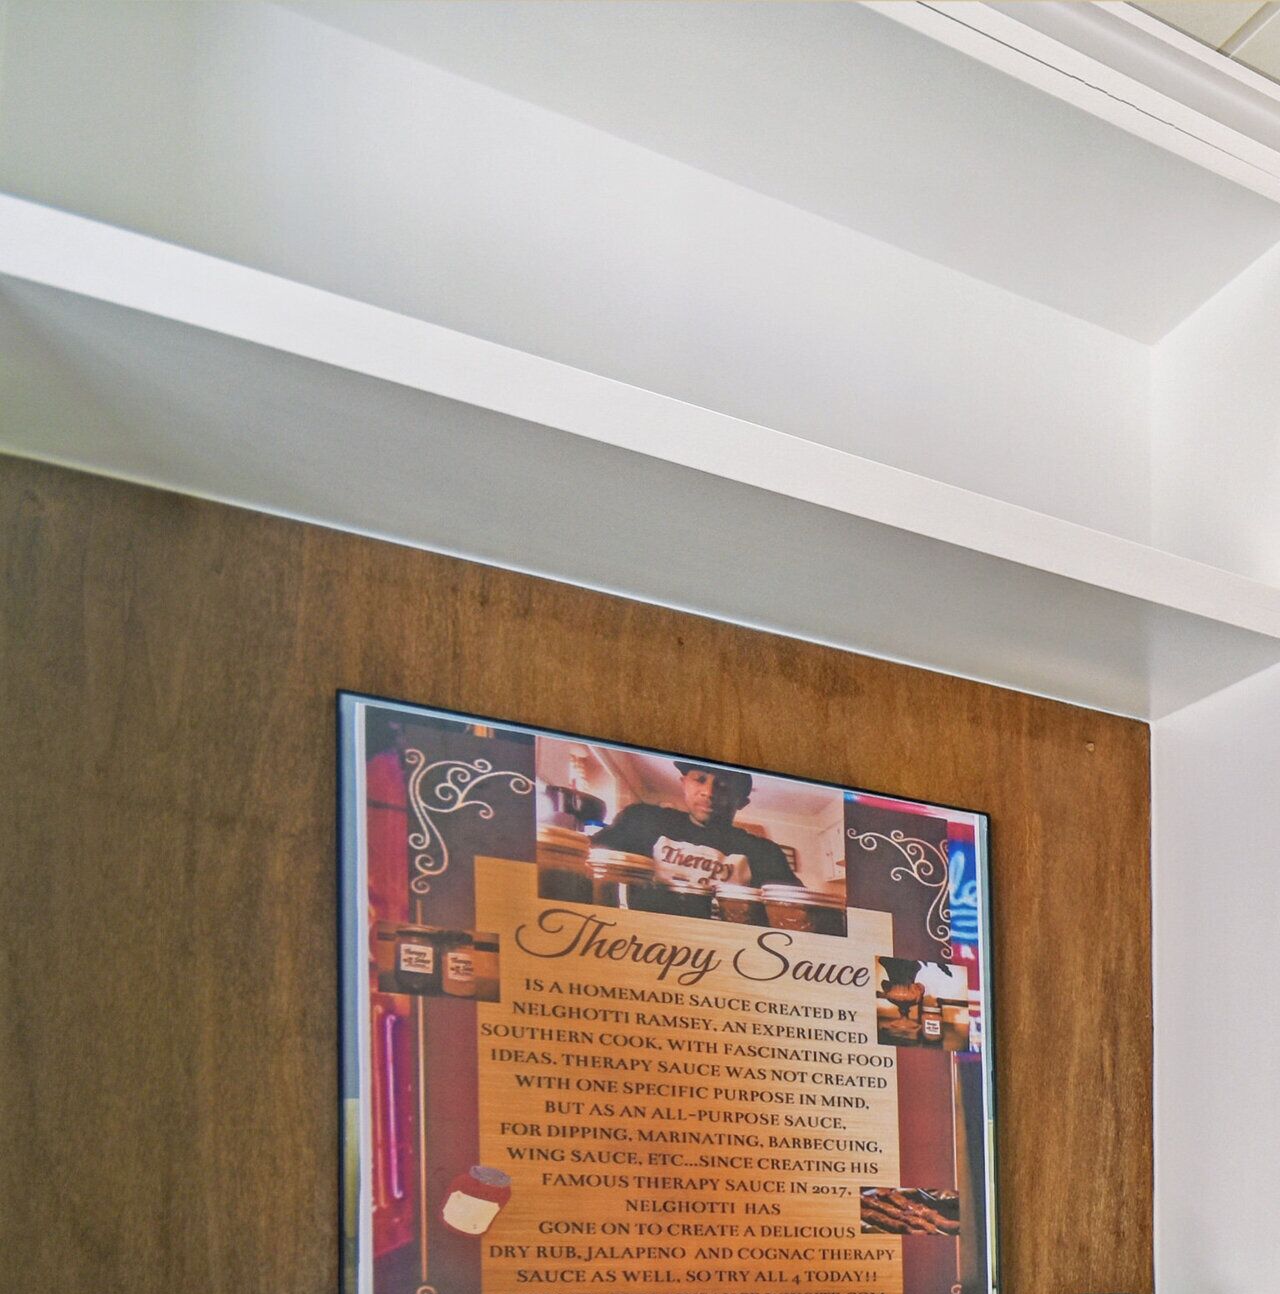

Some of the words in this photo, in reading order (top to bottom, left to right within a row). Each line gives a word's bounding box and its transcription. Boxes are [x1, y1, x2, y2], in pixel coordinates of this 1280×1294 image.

[515, 908, 721, 986] Therapy
[733, 931, 871, 987] Sauce
[525, 978, 544, 992] IS
[548, 981, 563, 994] A
[568, 982, 684, 1005] HOMEMADE
[688, 993, 750, 1012] SAUCE
[755, 1000, 833, 1020] CREATED
[838, 1009, 857, 1022] BY
[512, 1001, 630, 1024] NELGHOTTI
[721, 1021, 747, 1033] AN
[752, 1024, 868, 1044] EXPERIENCED
[481, 1023, 594, 1044] SOUTHERN
[667, 1038, 717, 1054] WITH
[724, 1043, 842, 1064] FASCINATING
[847, 1054, 894, 1068] FOOD
[562, 1053, 652, 1072] THERAPY
[657, 1060, 720, 1076] SAUCE
[725, 1065, 767, 1080] WAS
[771, 1070, 808, 1083] NOT
[812, 1072, 888, 1089] CREATED
[515, 1074, 570, 1090] WITH
[576, 1078, 618, 1093] ONE
[622, 1082, 709, 1099] SPECIFIC
[714, 1087, 795, 1105] PURPOSE
[800, 1093, 816, 1106] IN
[544, 1100, 585, 1115] BUT
[589, 1103, 614, 1117] AS
[619, 1105, 646, 1118] AN
[651, 1108, 780, 1126] ALL-PURPOSE
[500, 1122, 541, 1136] FOR
[507, 1147, 565, 1161] WING
[757, 1158, 846, 1173] CREATING
[851, 1162, 879, 1174] HIS
[542, 1173, 629, 1188] FAMOUS
[633, 1175, 720, 1191] THERAPY
[725, 1180, 785, 1193] SAUCE
[790, 1182, 808, 1194] IN
[625, 1199, 735, 1214] NELGHOTTI
[744, 1202, 781, 1215] HAS
[538, 1221, 596, 1235] GONE
[601, 1222, 630, 1235] ON
[635, 1223, 663, 1236] TO
[667, 1223, 738, 1237] CREATE
[743, 1225, 756, 1237] A
[761, 1226, 856, 1238] DELICIOUS
[489, 1245, 530, 1259] DRY
[585, 1246, 686, 1262] JALAPENO
[695, 1247, 737, 1260] AND
[738, 1247, 815, 1261] COGNAC
[818, 1248, 896, 1261] THERAPY
[516, 1269, 586, 1283] SAUCE
[591, 1270, 616, 1283] AS
[686, 1270, 711, 1283] SO
[715, 1270, 750, 1283] TRY
[754, 1270, 789, 1283] ALL
[791, 1273, 801, 1285] 4
[804, 1270, 877, 1283] TODAY!!
